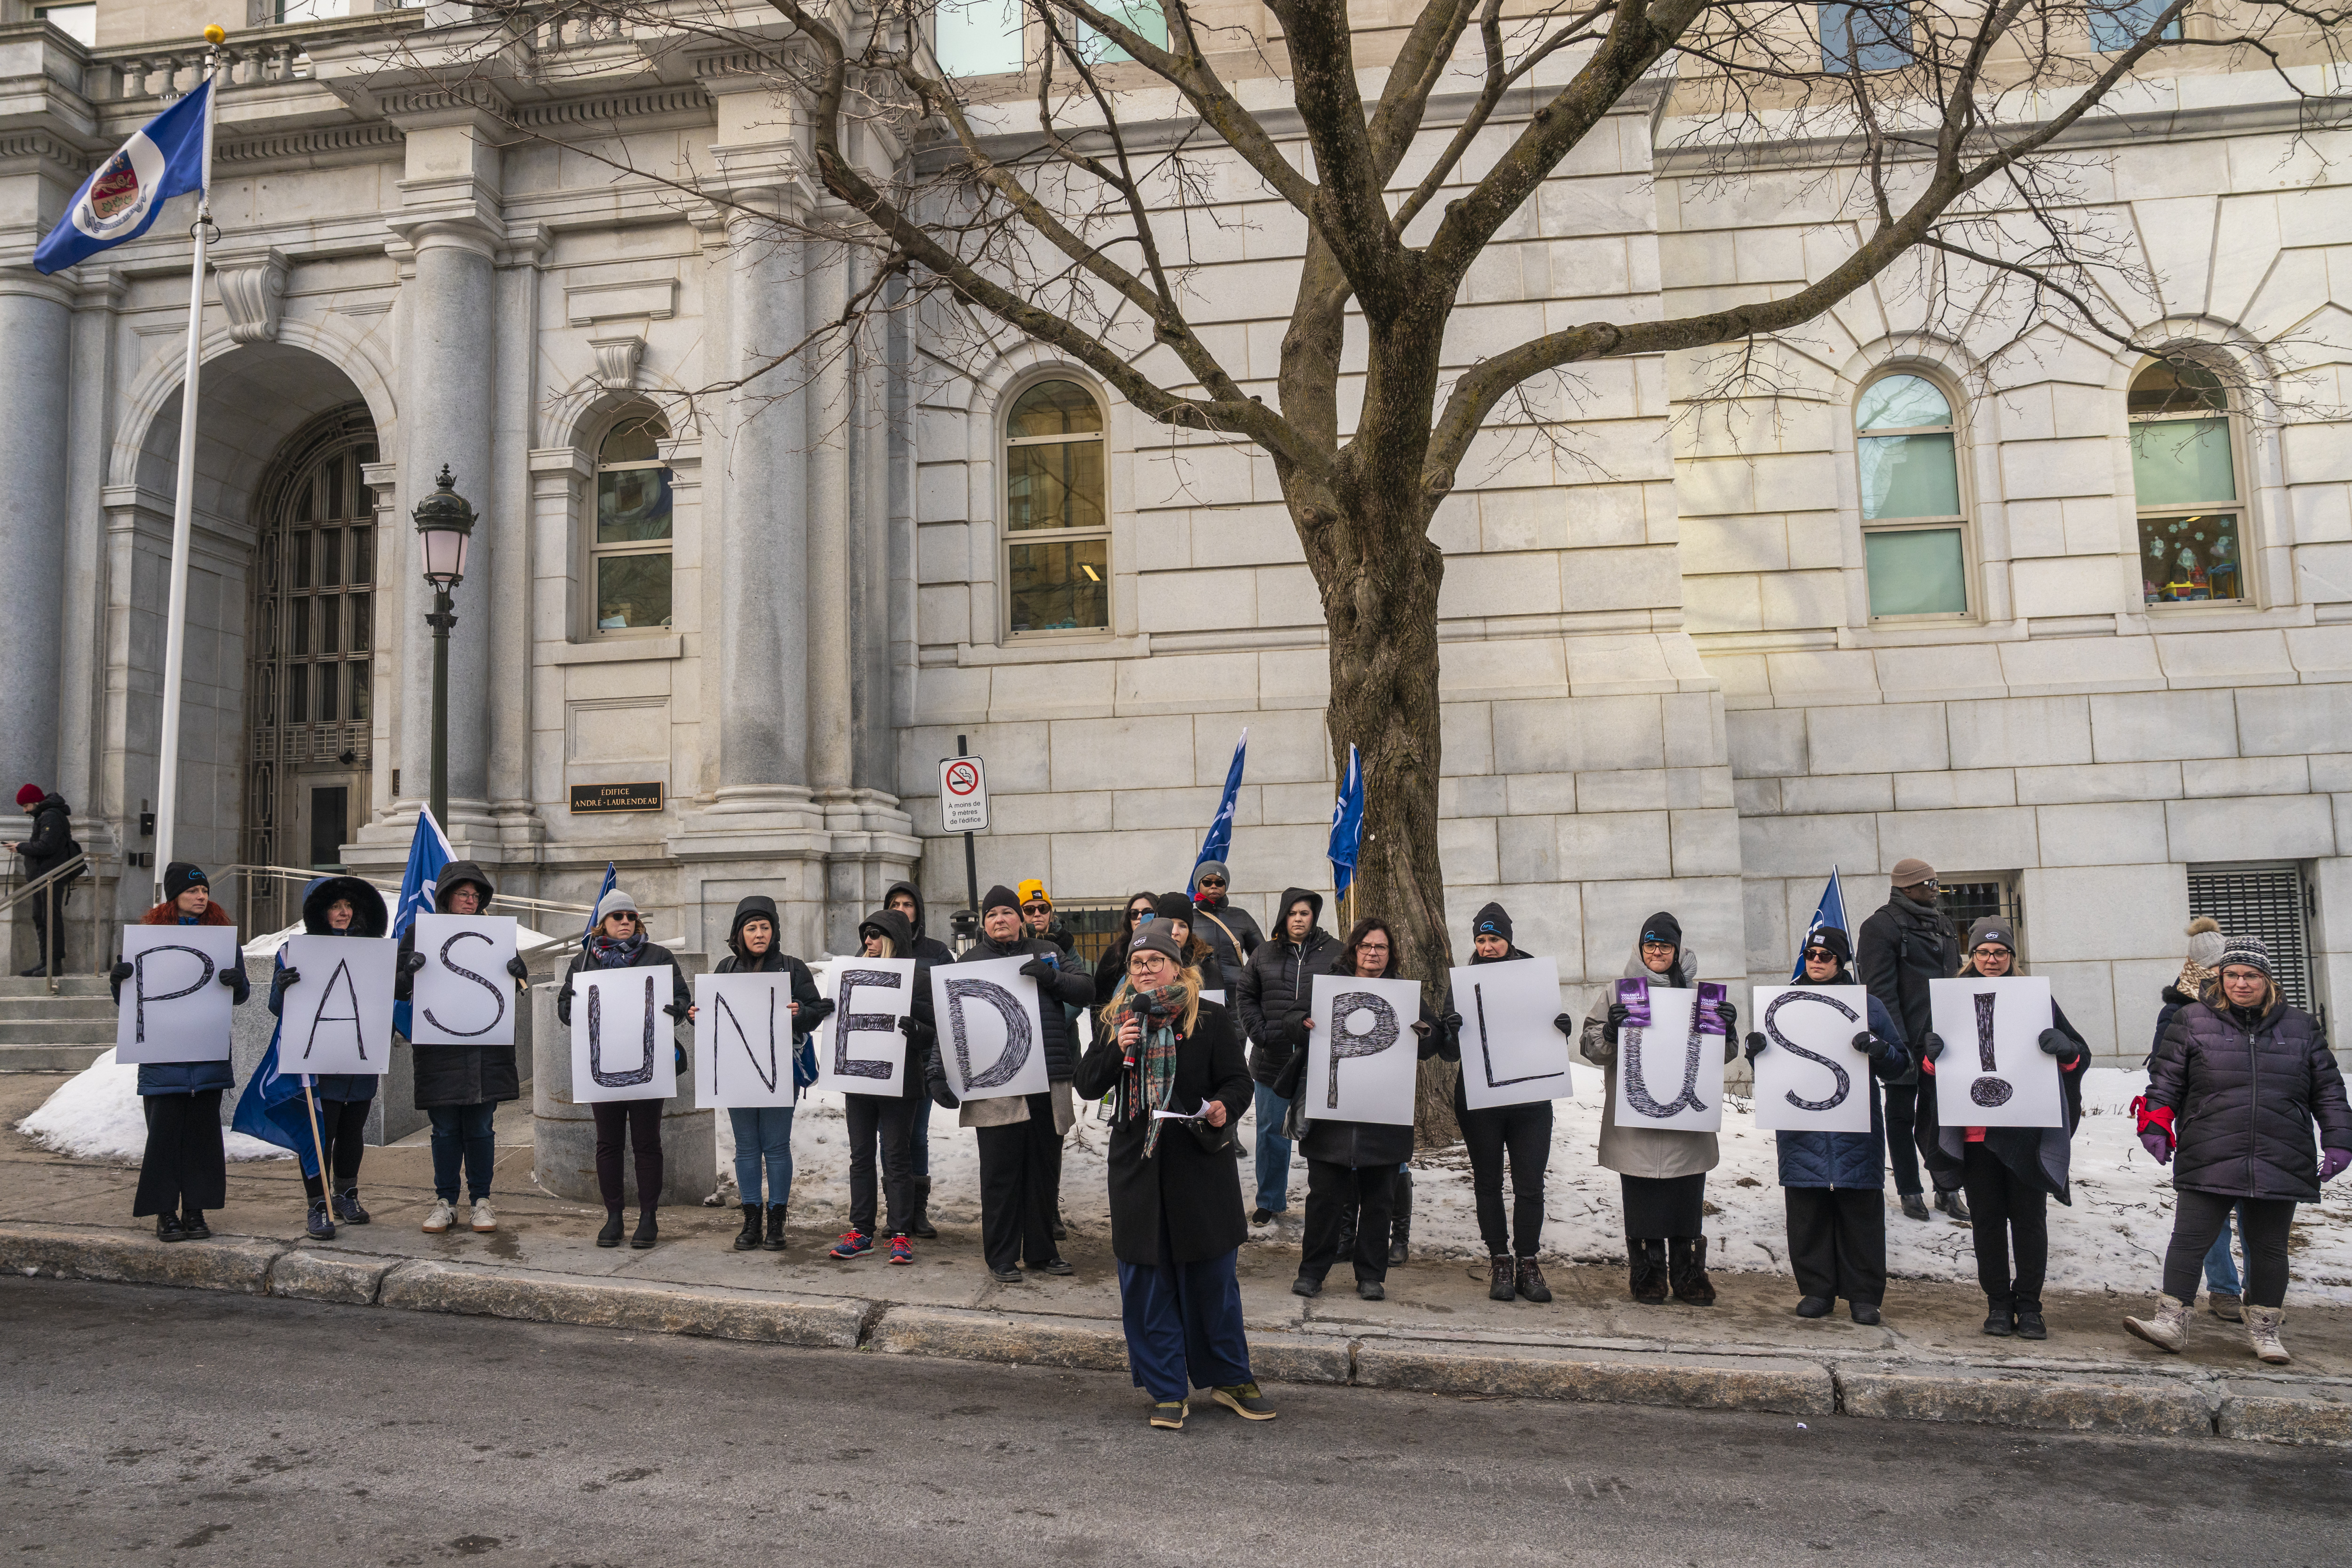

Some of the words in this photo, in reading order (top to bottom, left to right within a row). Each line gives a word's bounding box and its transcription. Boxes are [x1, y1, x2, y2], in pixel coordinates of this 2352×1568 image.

[601, 787, 629, 796] ÉDIFICE
[135, 945, 215, 1044] P
[303, 958, 368, 1061] A
[423, 931, 505, 1037] S
[588, 976, 655, 1088] U
[834, 969, 902, 1080] E
[945, 978, 1032, 1093] D
[1475, 982, 1565, 1088] L
[714, 987, 777, 1096] N
[1327, 992, 1400, 1109] P
[1623, 1002, 1708, 1118] U
[1764, 991, 1861, 1112] S
[1971, 992, 2013, 1108] !
